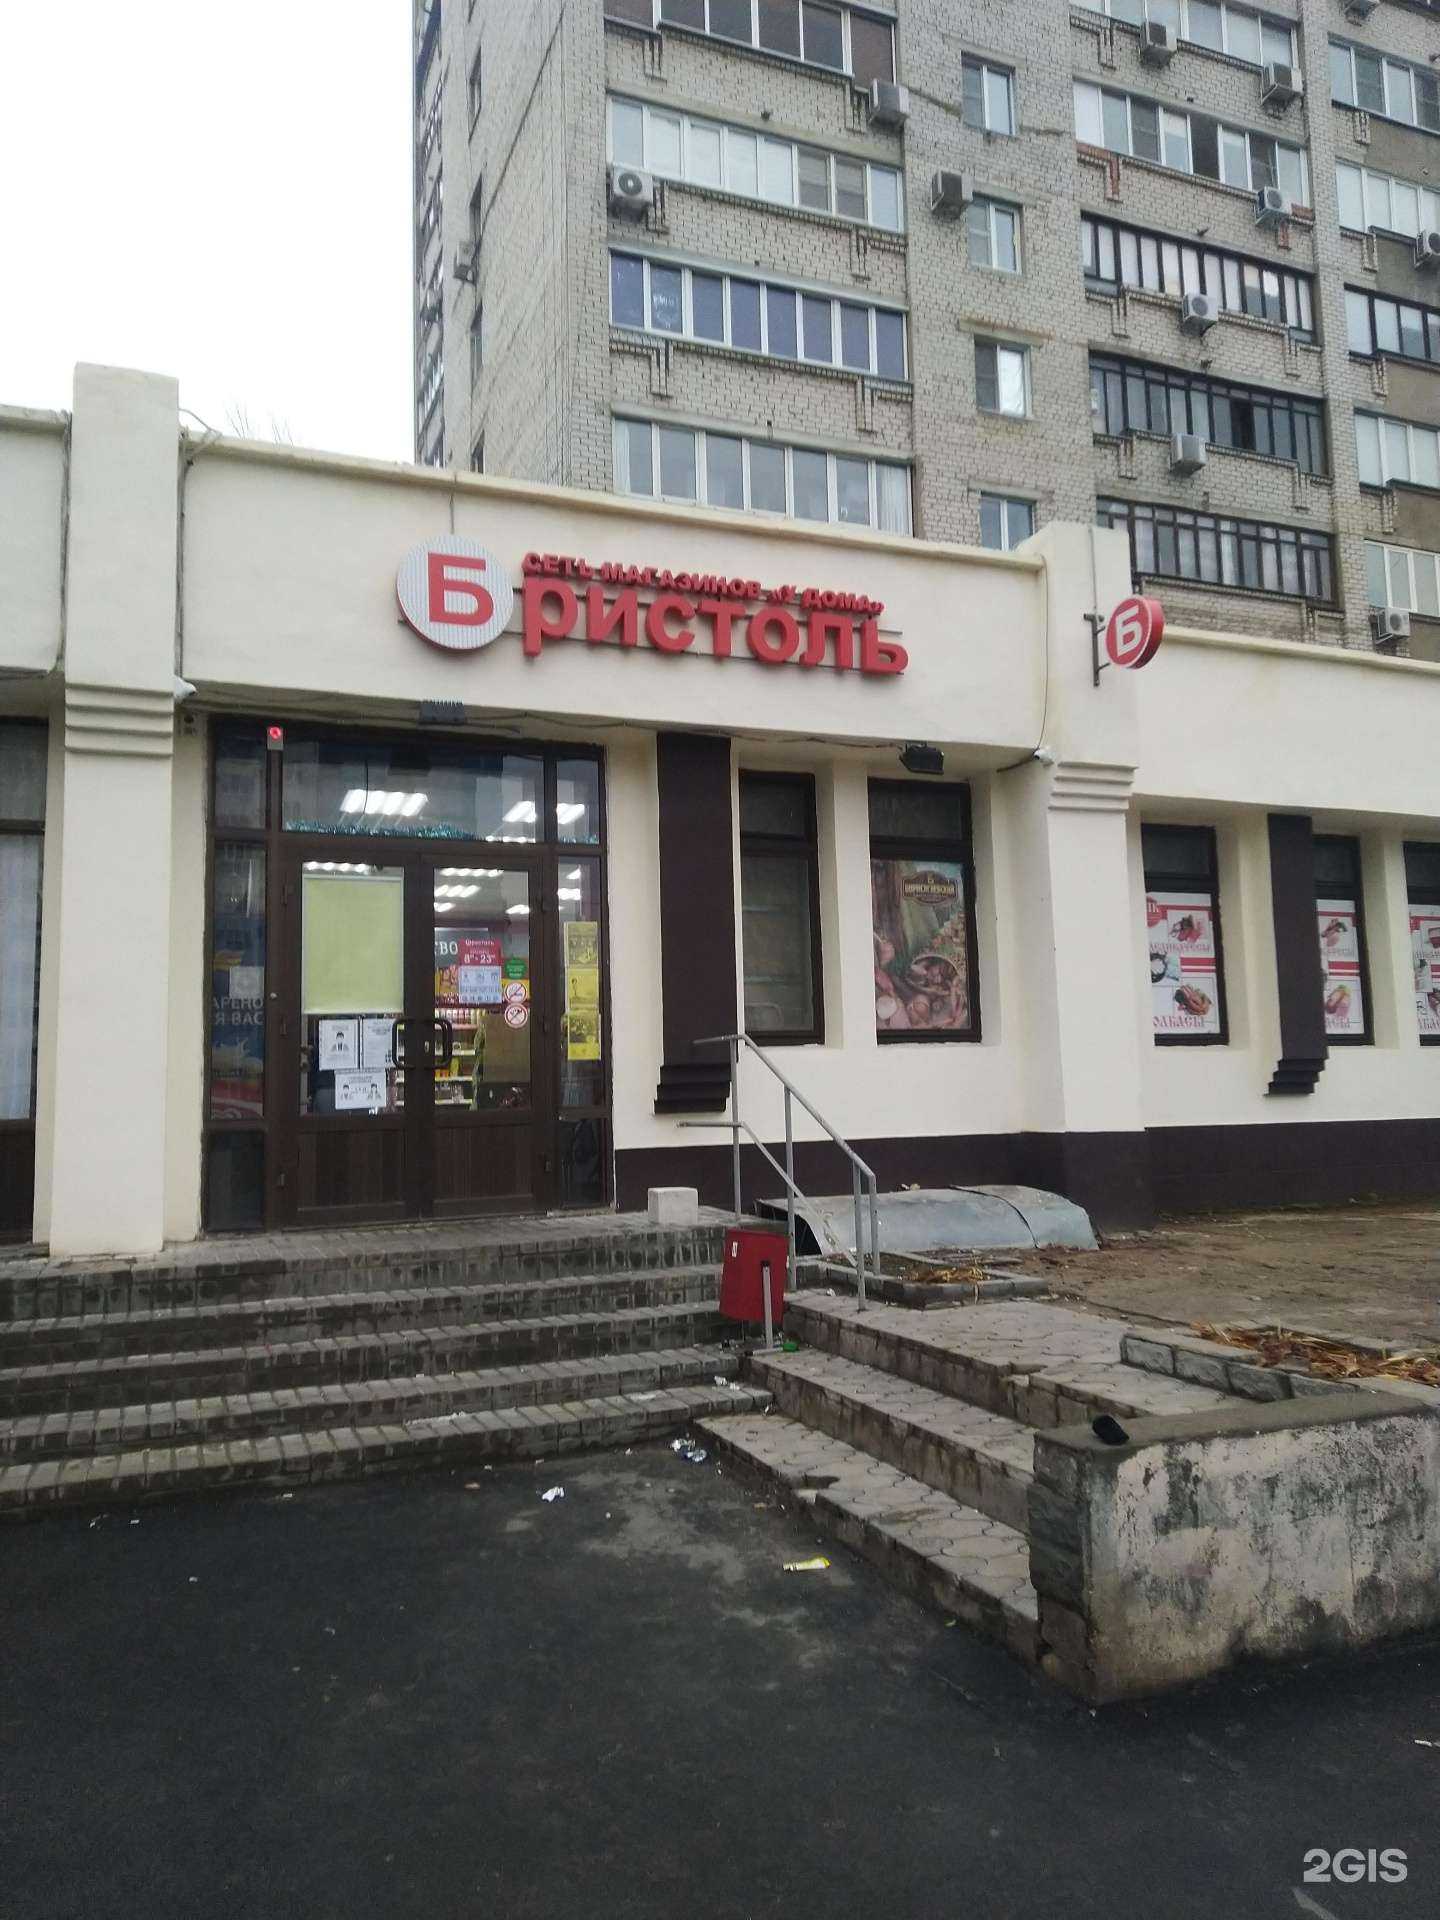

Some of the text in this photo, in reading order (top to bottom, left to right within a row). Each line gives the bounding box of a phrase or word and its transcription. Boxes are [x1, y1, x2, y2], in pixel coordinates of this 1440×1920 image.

[522, 552, 593, 580] СЕТЬ
[600, 562, 761, 600] МАГАЗИНОВ
[1115, 604, 1143, 657] Б
